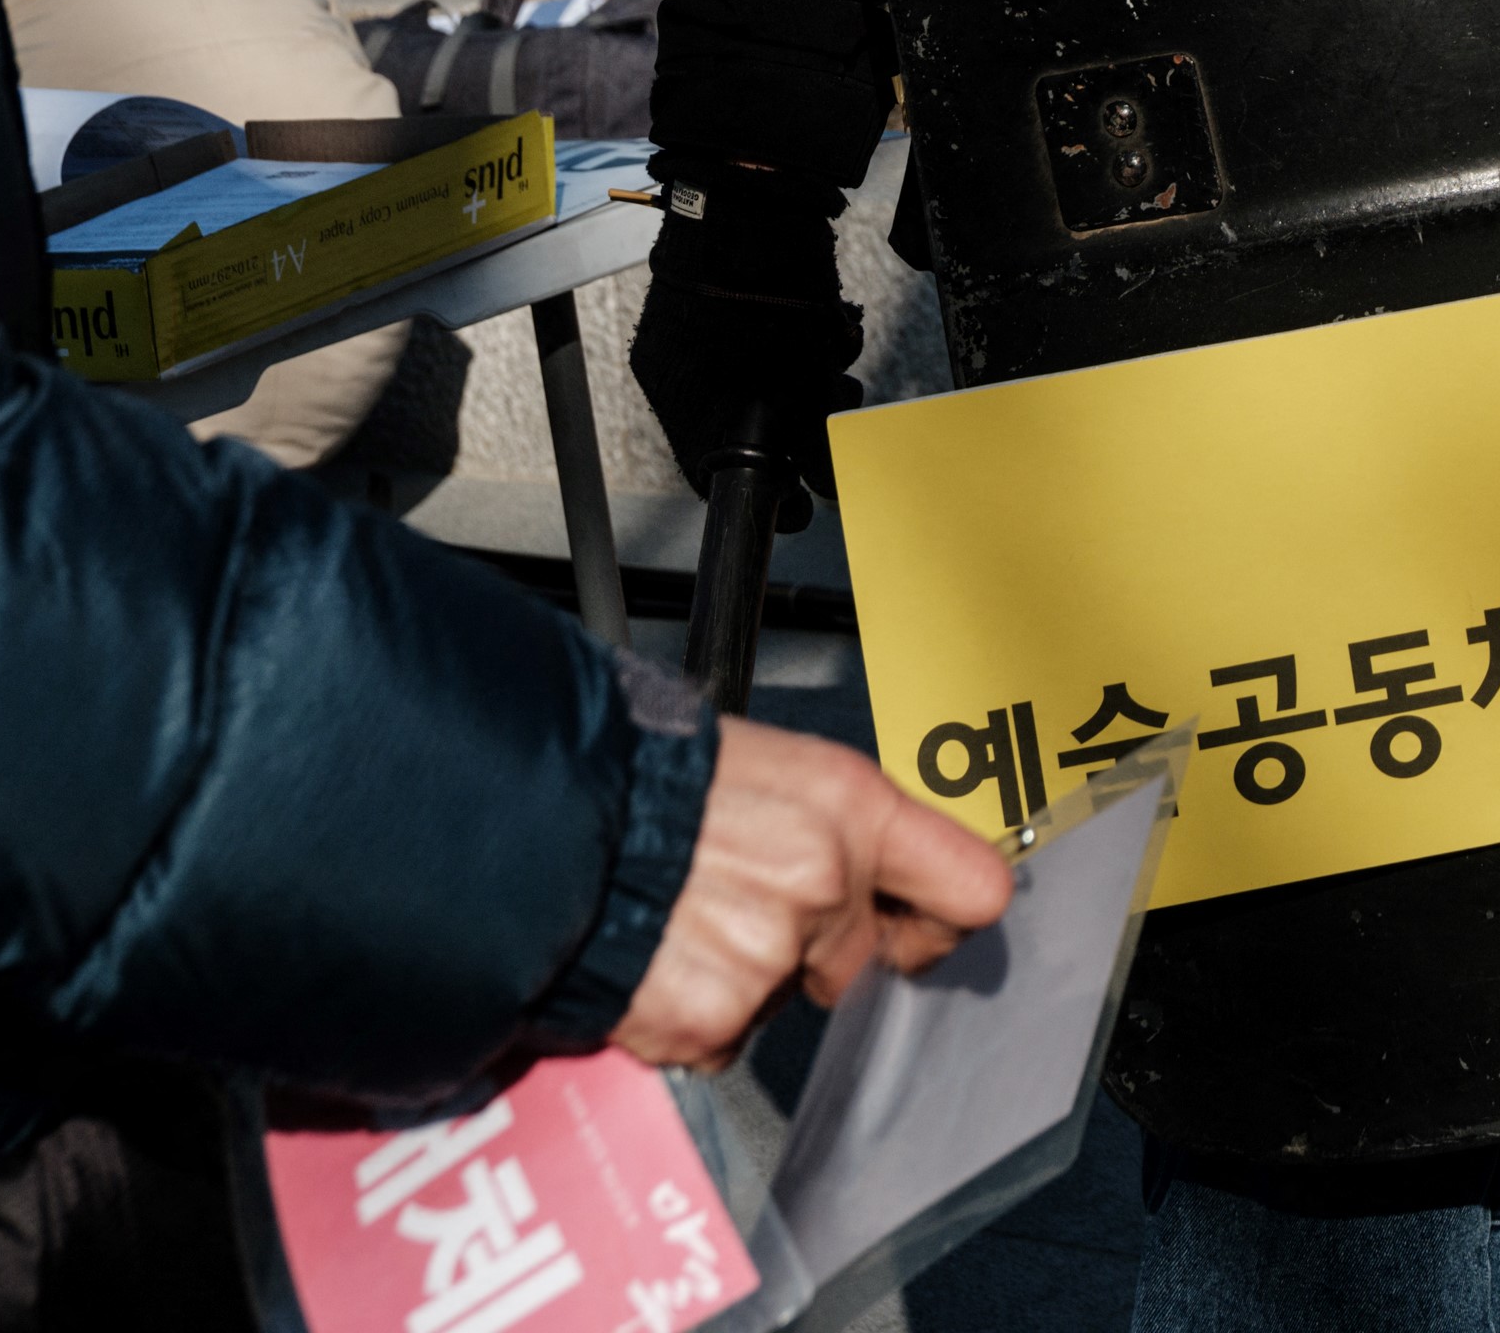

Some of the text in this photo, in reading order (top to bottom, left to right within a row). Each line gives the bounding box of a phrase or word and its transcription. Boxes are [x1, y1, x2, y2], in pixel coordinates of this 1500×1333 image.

[463, 136, 524, 201] plus
[319, 182, 450, 243] Premium Copy Paper
[188, 255, 259, 291] 210x297mm
[272, 238, 307, 282] A4
[53, 290, 119, 357] plu
